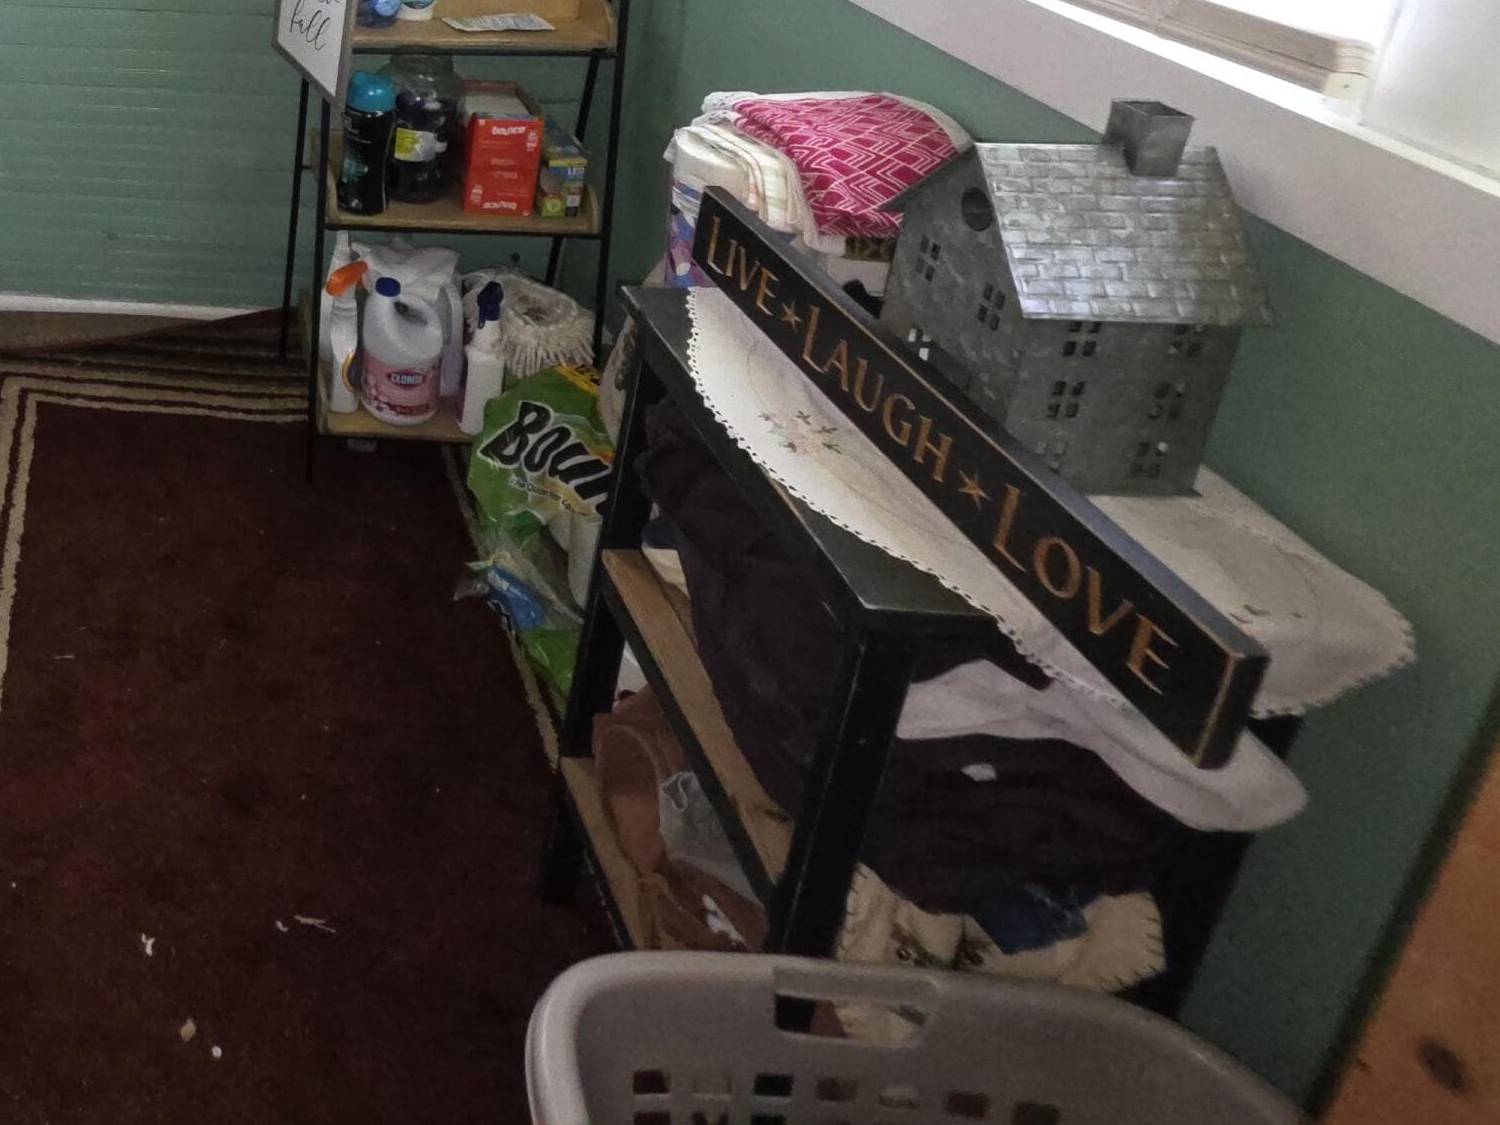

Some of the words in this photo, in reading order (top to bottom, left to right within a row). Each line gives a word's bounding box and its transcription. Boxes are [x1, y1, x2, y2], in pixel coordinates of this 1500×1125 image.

[707, 215, 780, 317] LIVE
[802, 305, 952, 482] LAUGH
[993, 482, 1180, 696] LOVE
